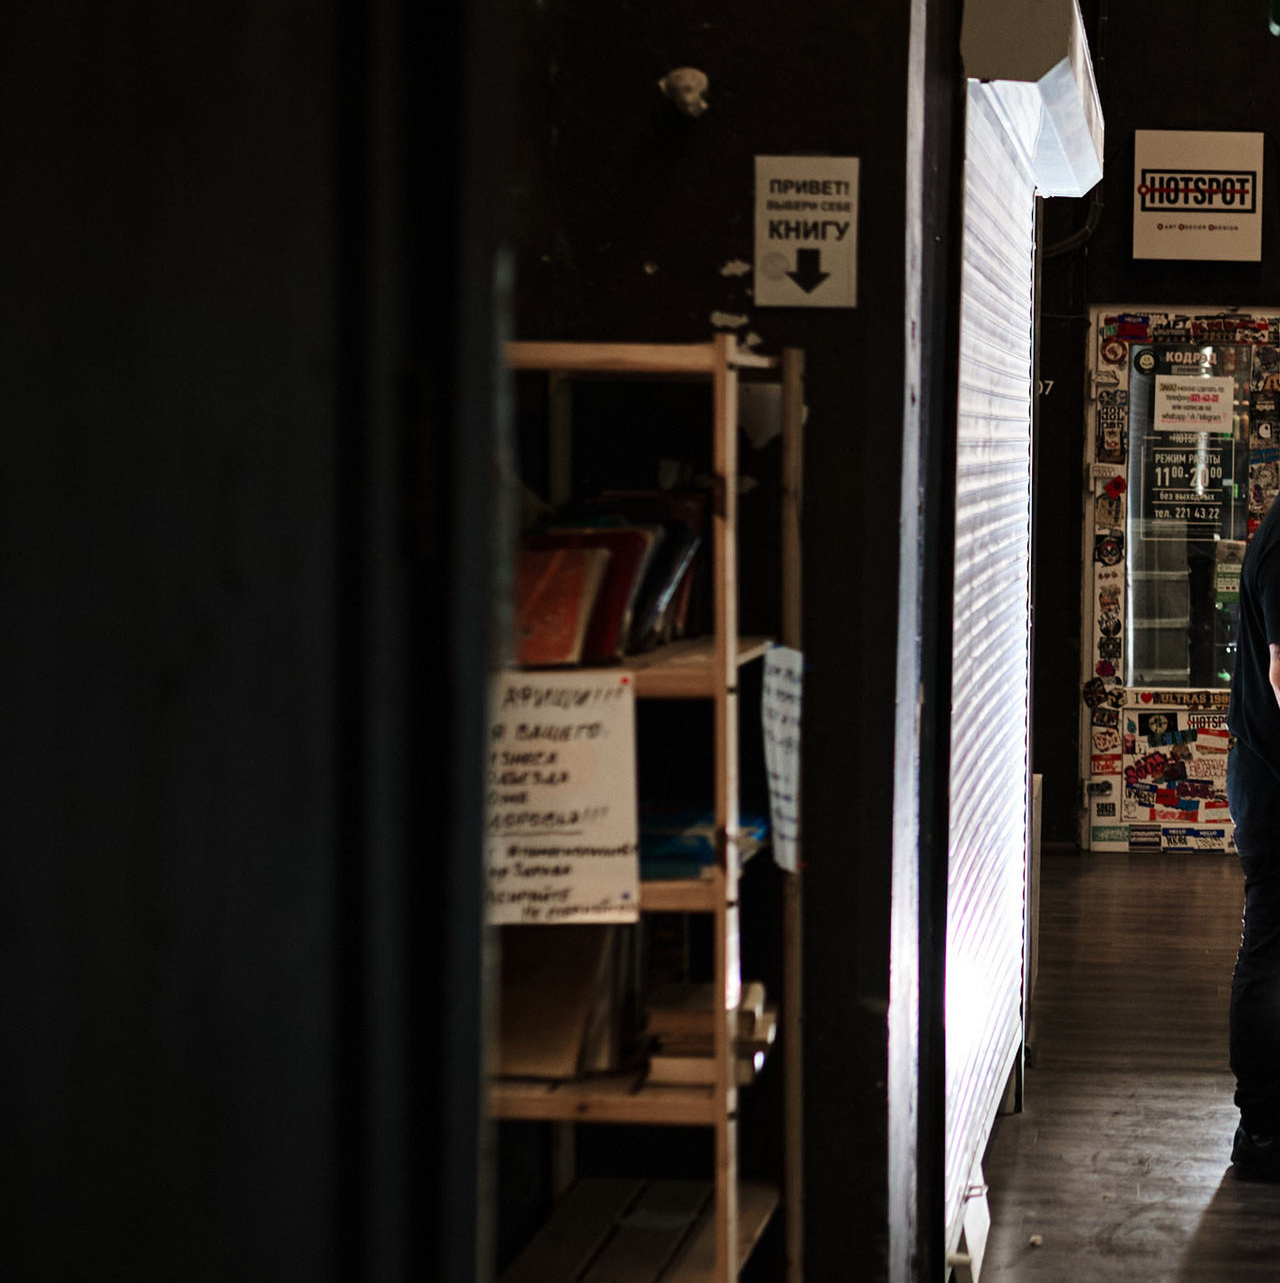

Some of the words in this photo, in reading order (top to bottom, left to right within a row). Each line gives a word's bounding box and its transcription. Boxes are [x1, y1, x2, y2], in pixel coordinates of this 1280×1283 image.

[769, 179, 850, 196] ПРИВЕТ!
[1150, 176, 1249, 205] HOTSPOT
[769, 220, 850, 241] КНИГУ
[1155, 453, 1186, 464] РЕЖИМ
[1160, 492, 1173, 501] без
[1175, 493, 1215, 502] выходных
[1154, 509, 1172, 518] тел.
[1175, 507, 1191, 518] 221
[1194, 507, 1206, 519] 43
[1208, 507, 1220, 519] 22
[1161, 692, 1207, 704] ULTRAS
[1192, 715, 1227, 730] HOTSP
